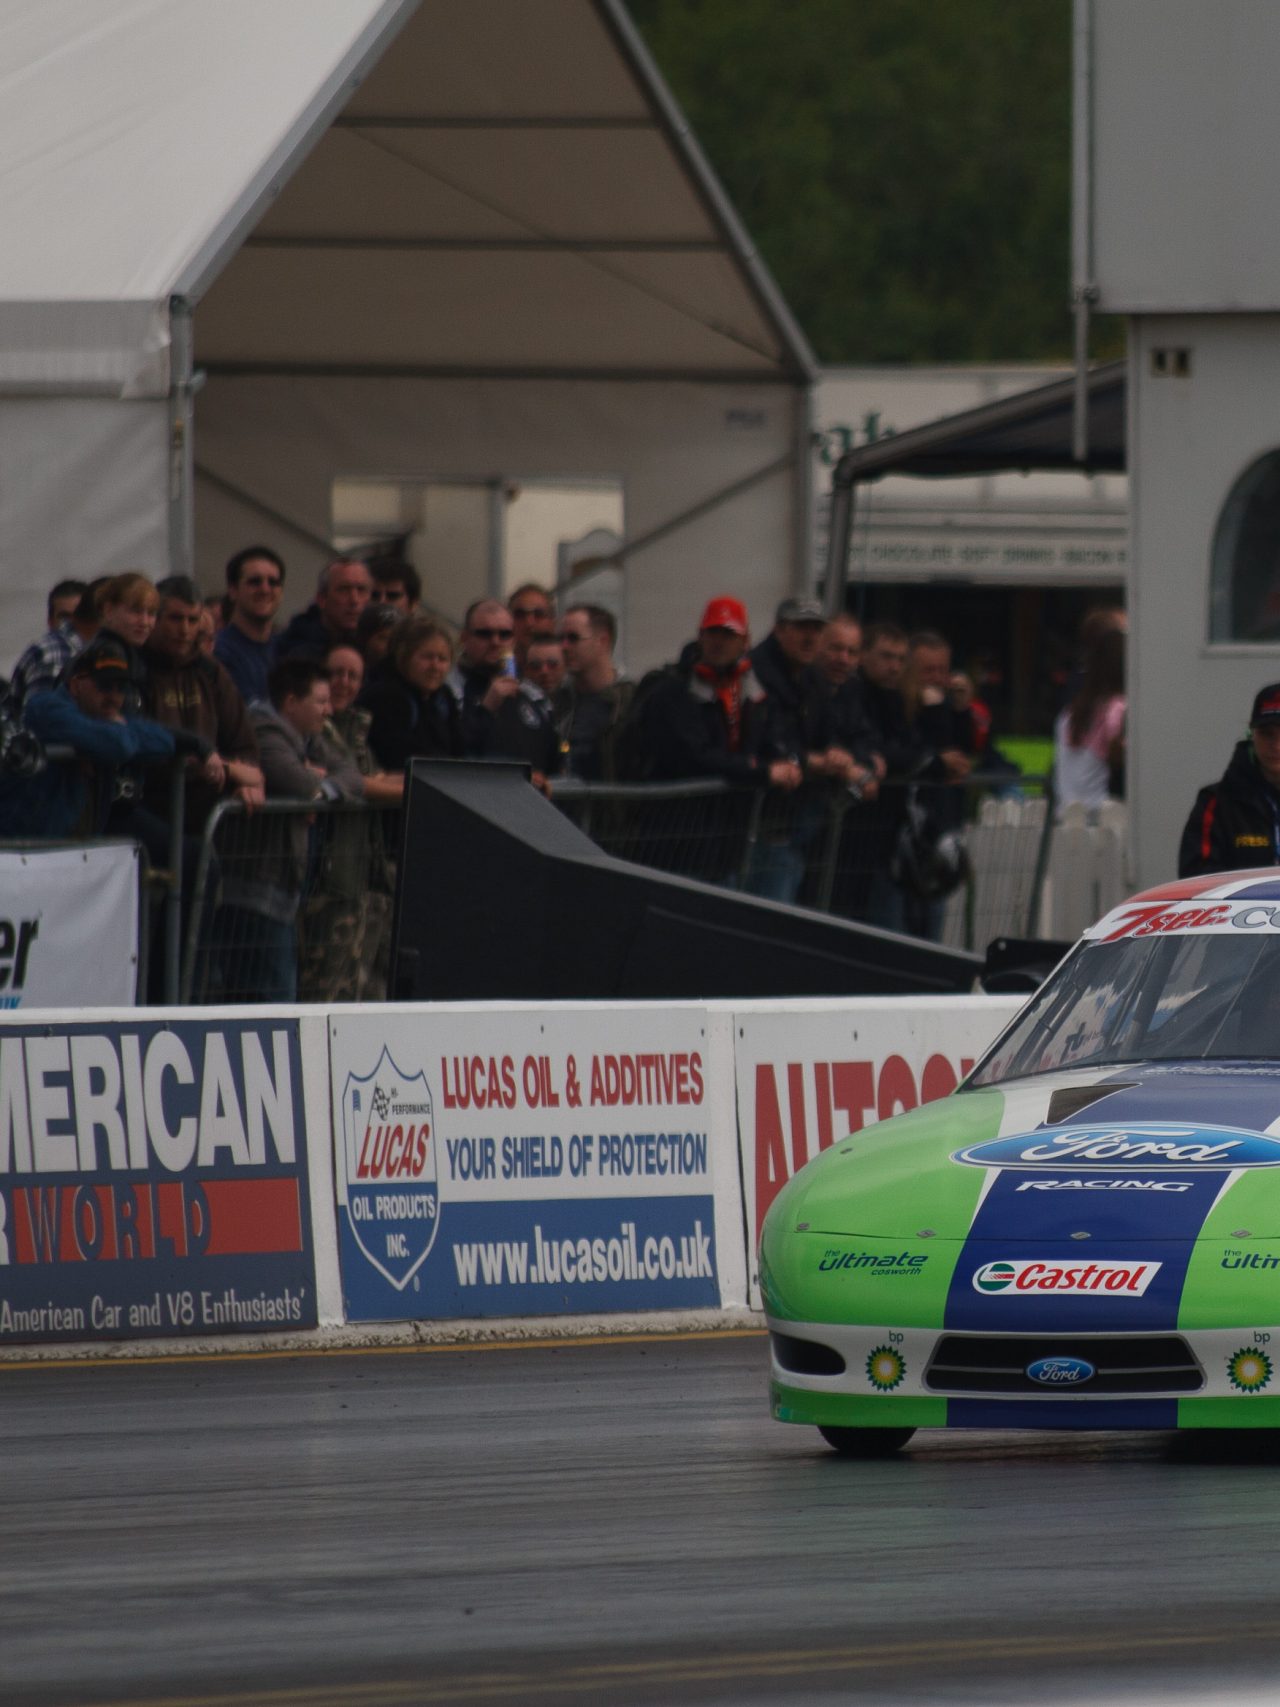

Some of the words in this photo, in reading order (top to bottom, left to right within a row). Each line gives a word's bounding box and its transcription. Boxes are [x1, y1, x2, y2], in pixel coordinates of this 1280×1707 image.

[441, 1054, 517, 1110] LUCAS
[522, 1054, 560, 1109] OIL
[565, 1053, 583, 1109] &
[590, 1051, 705, 1107] ADDITIVES
[391, 1103, 431, 1116] PERFORMANCE
[356, 1122, 430, 1180] LUCAS
[446, 1137, 496, 1181] YOUR
[501, 1135, 563, 1180] SHIELD
[568, 1133, 594, 1178] OF
[599, 1132, 708, 1177] PROTECTION
[1020, 1130, 1246, 1163] Ford
[1015, 1179, 1195, 1193] RACING
[352, 1196, 374, 1222] OIL
[376, 1194, 436, 1222] PRODUCTS
[24, 1183, 211, 1266] WORLD
[385, 1232, 410, 1258] INC.
[453, 1219, 714, 1287] www.lucasoil.co.uk
[1223, 1249, 1242, 1257] the
[870, 1267, 922, 1277] cosworth
[1015, 1263, 1148, 1291] Castrol
[0, 1301, 84, 1334] American
[91, 1294, 122, 1330] Car
[129, 1292, 161, 1328] and
[166, 1291, 195, 1326] V8
[201, 1287, 306, 1325] Enthusiasts'
[888, 1330, 904, 1344] bp
[1253, 1330, 1272, 1345] bp
[1038, 1360, 1081, 1383] Ford
